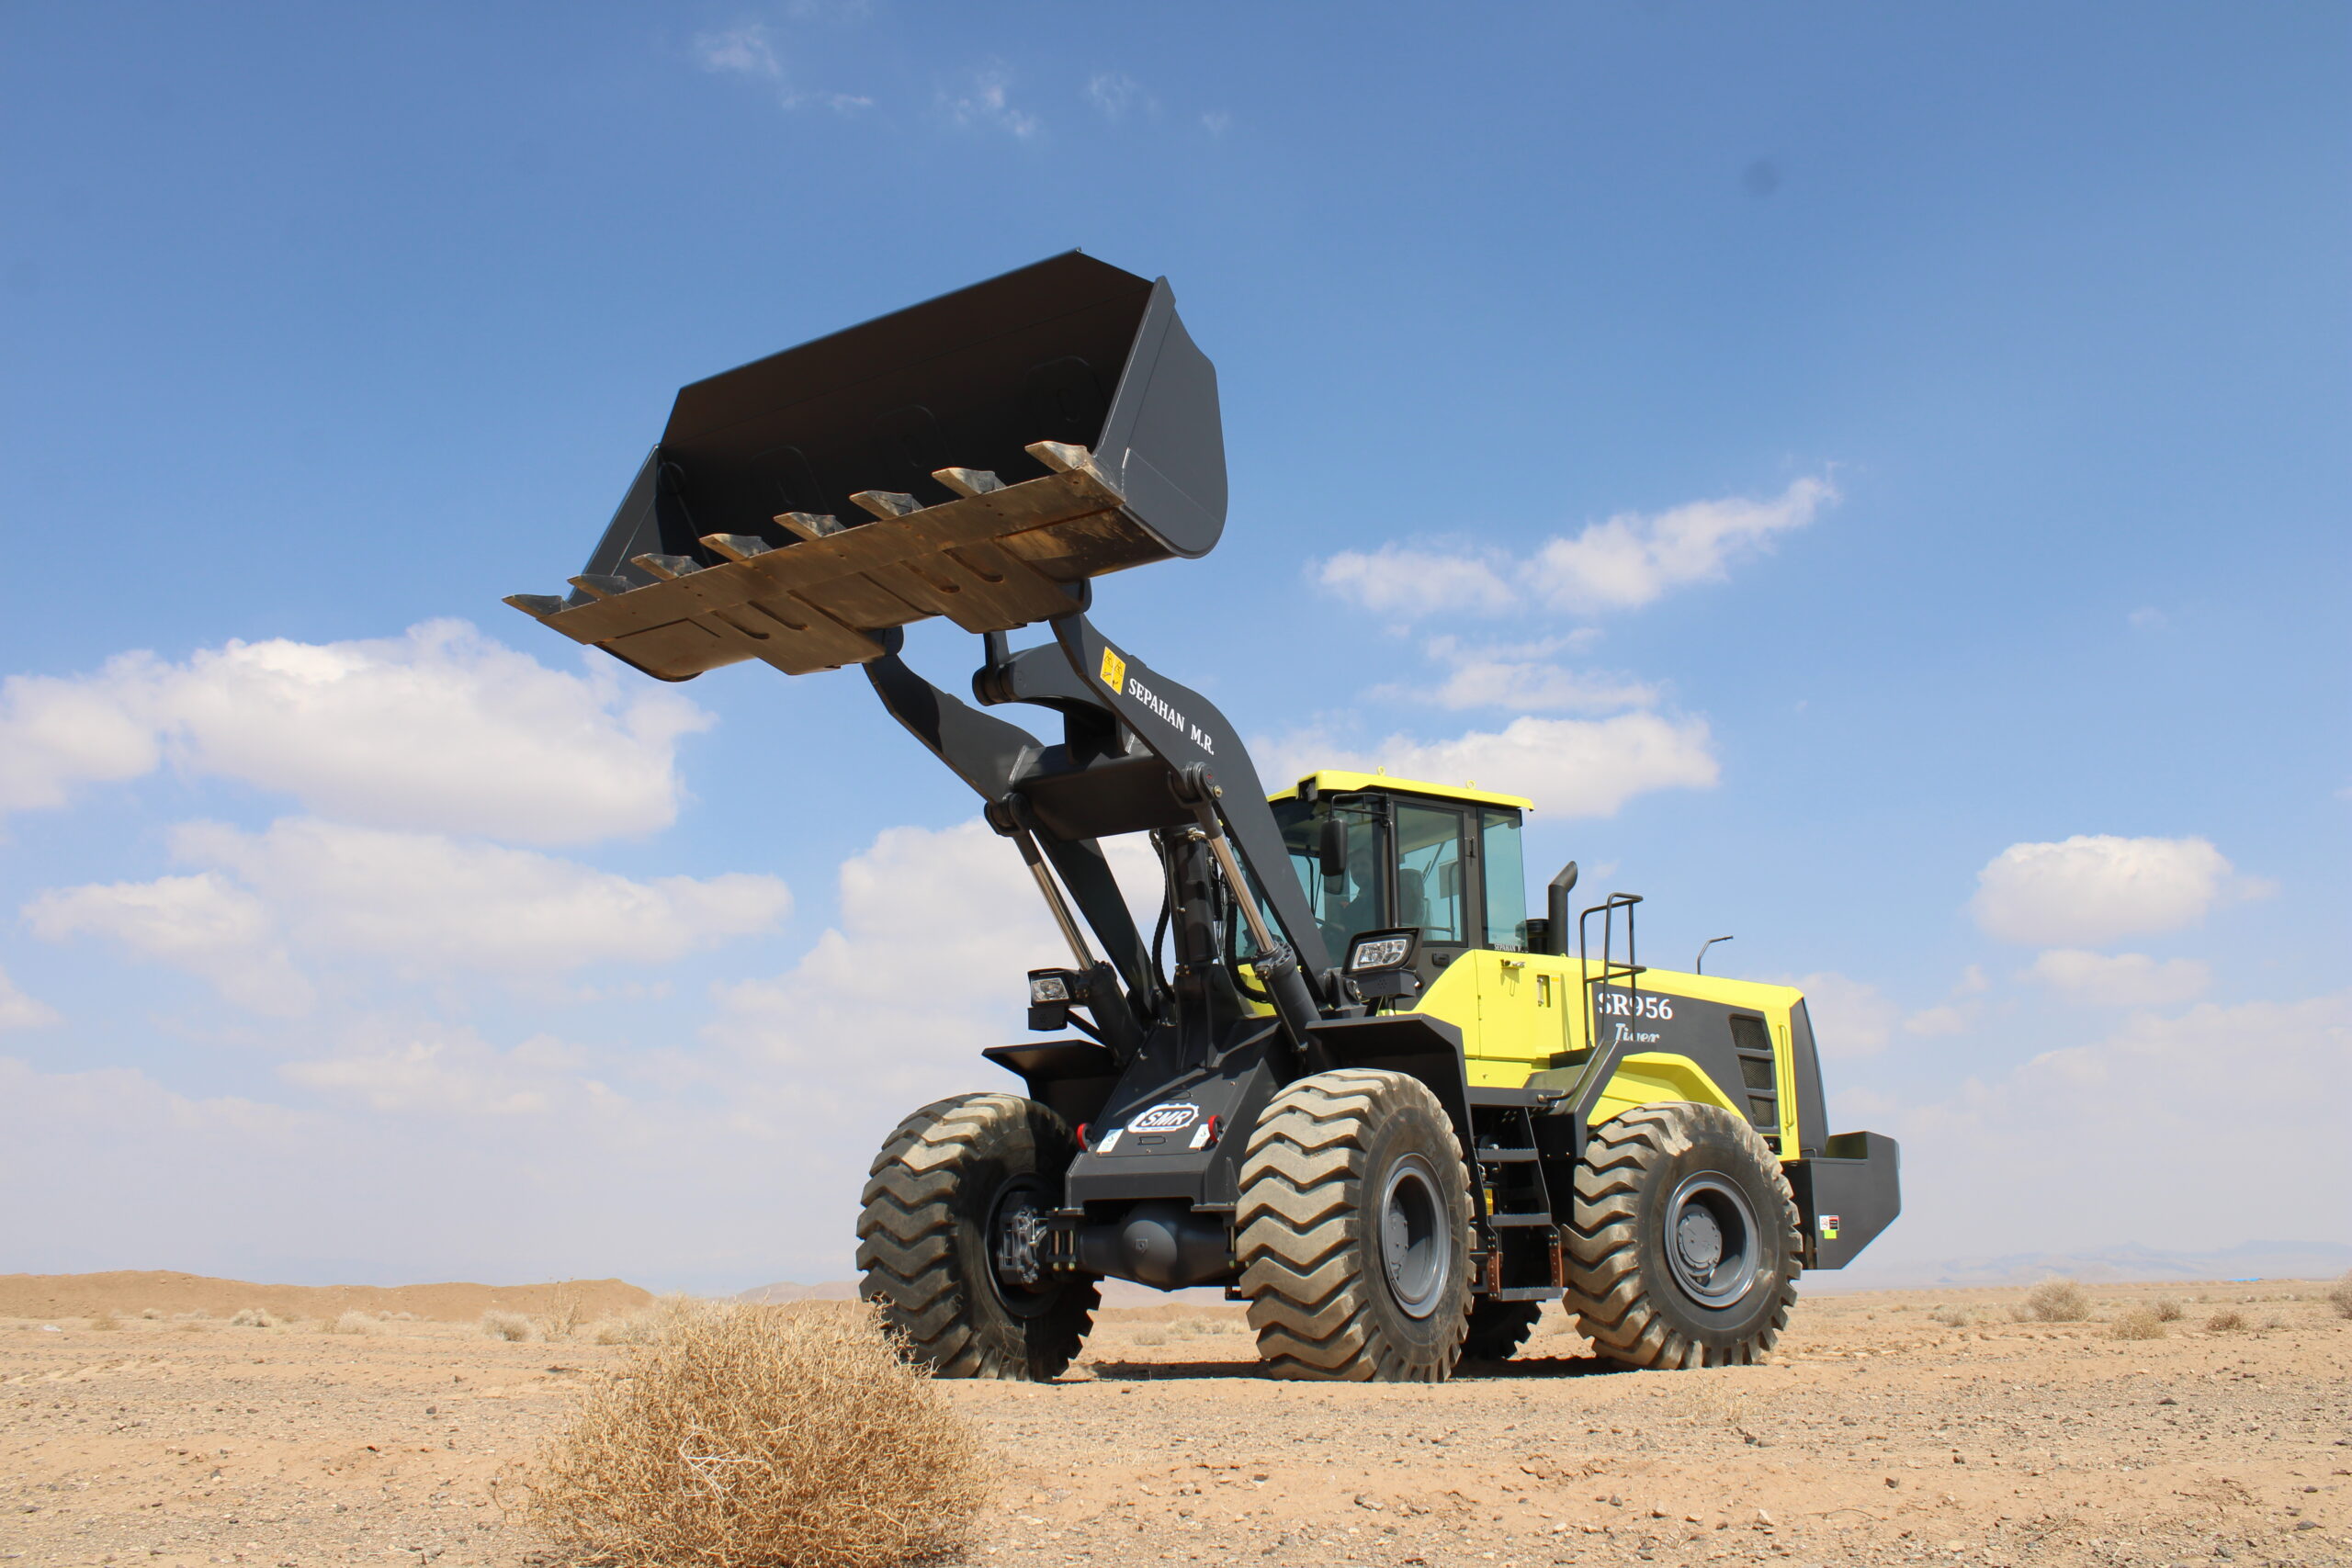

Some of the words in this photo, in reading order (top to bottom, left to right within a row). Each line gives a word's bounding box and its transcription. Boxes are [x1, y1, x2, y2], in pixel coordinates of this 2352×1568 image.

[1128, 678, 1185, 732] SEPAHAN
[1191, 724, 1215, 756] M.R.
[1598, 992, 1674, 1021] SR956
[1141, 1110, 1193, 1127] SMR
